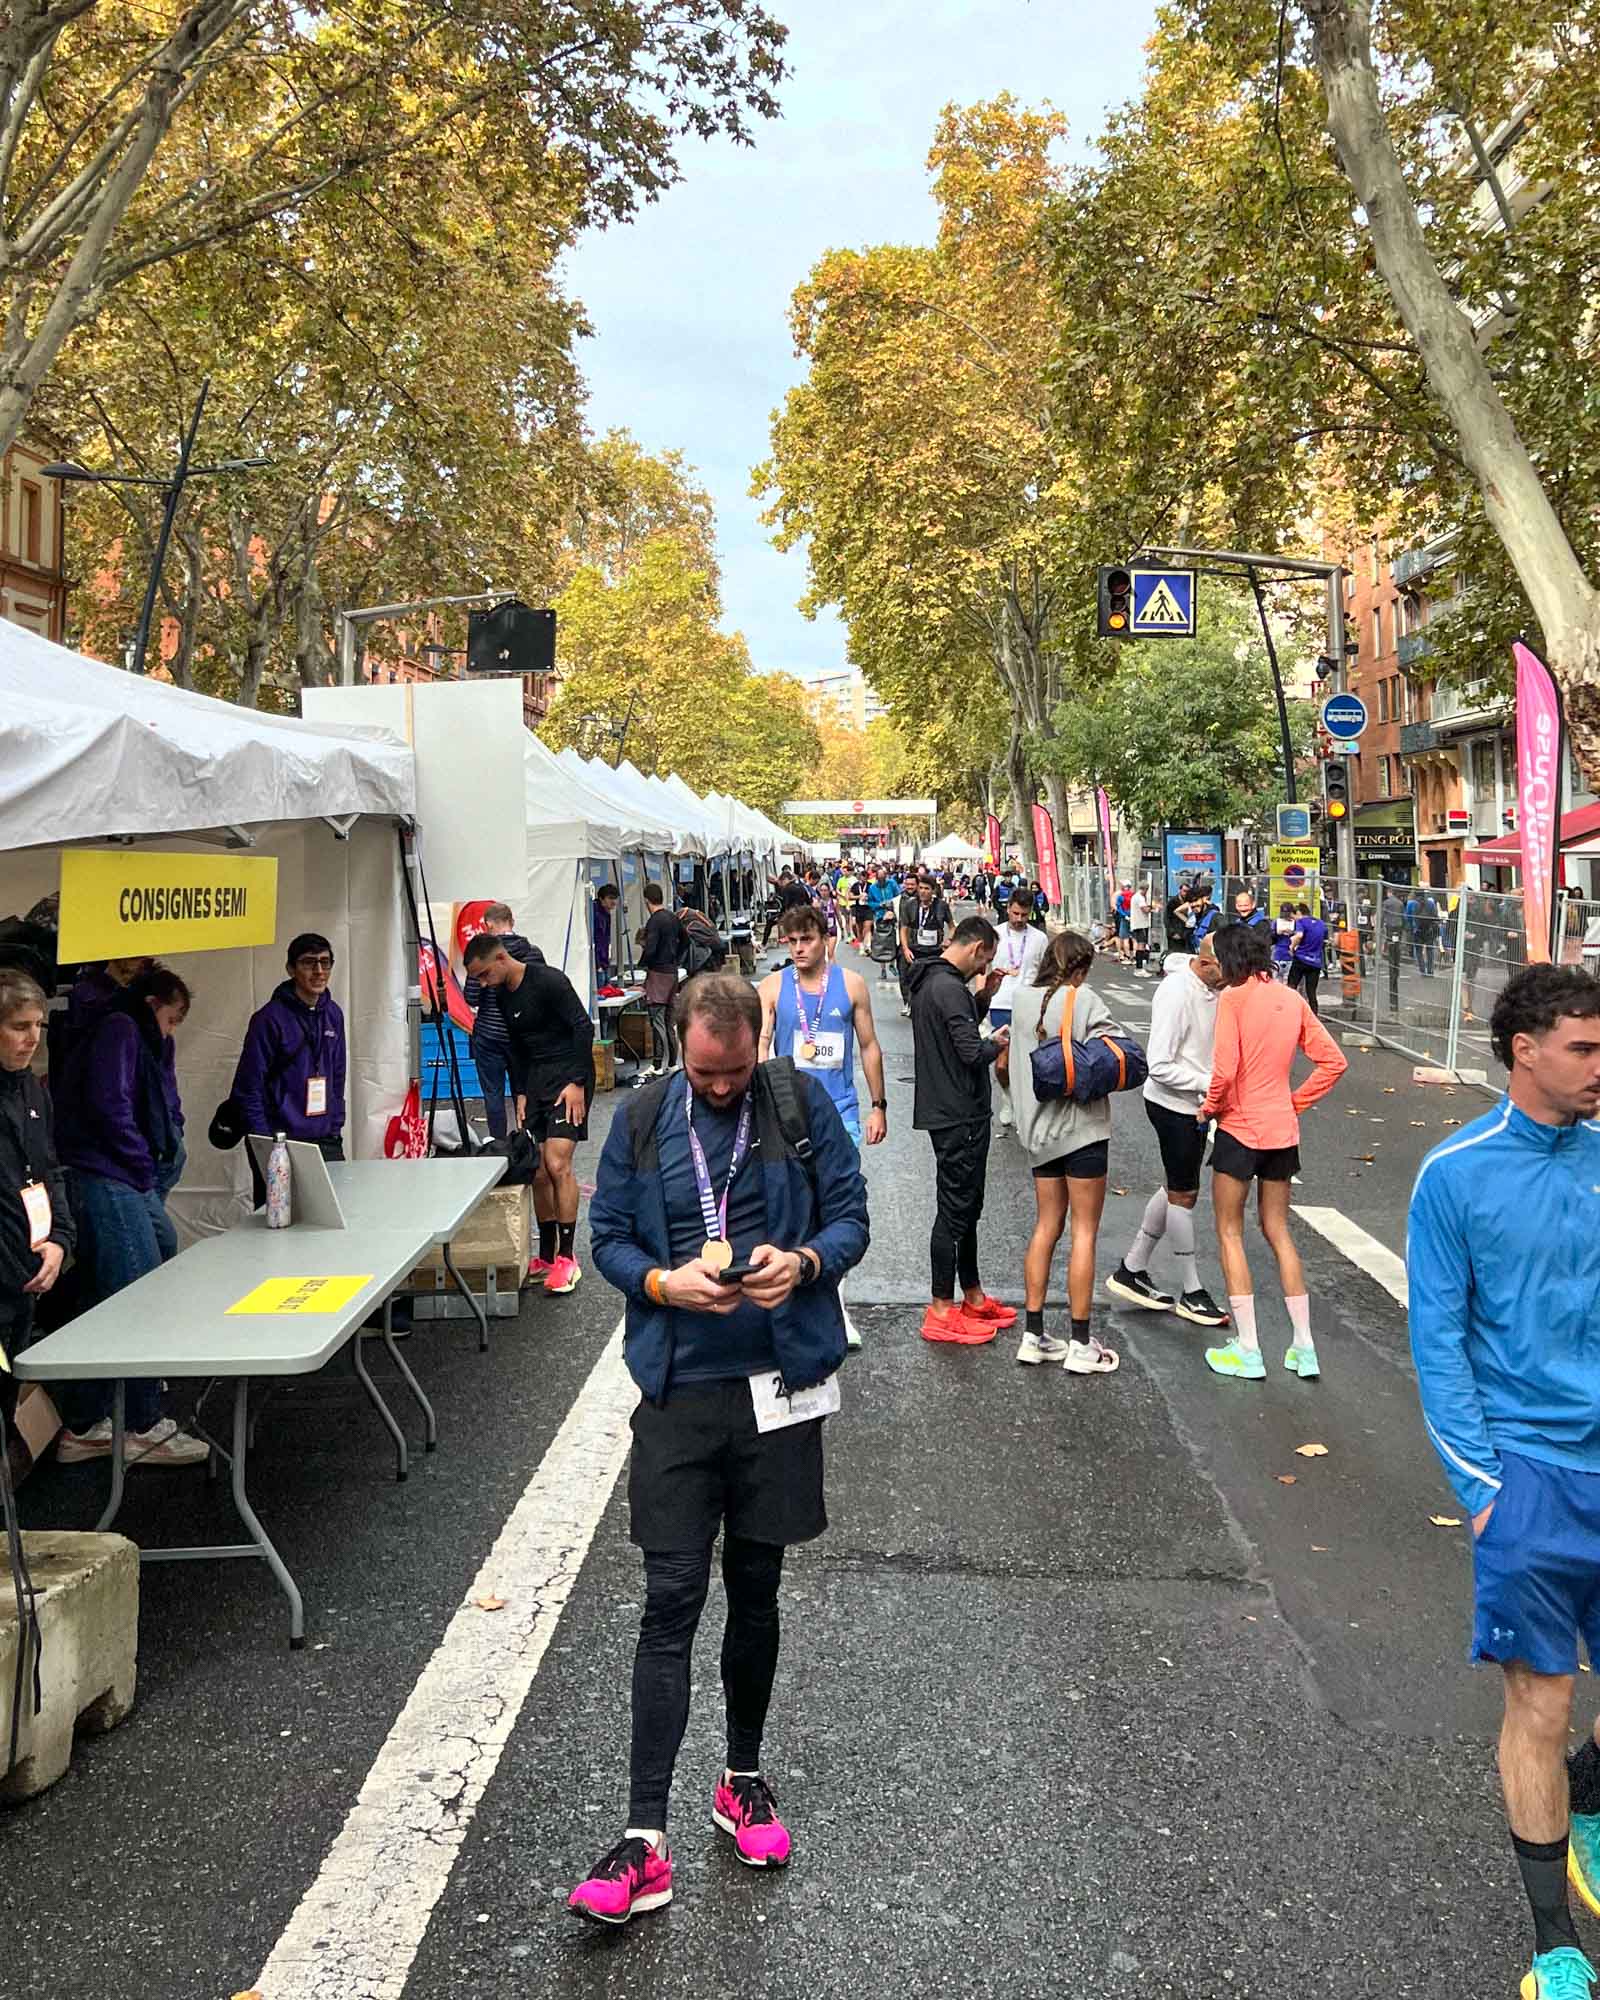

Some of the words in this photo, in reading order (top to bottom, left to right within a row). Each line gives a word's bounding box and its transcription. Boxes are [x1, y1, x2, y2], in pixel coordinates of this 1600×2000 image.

[1389, 834, 1413, 845] POT
[119, 887, 211, 922] CONSIGNES
[214, 887, 247, 918] SEMI
